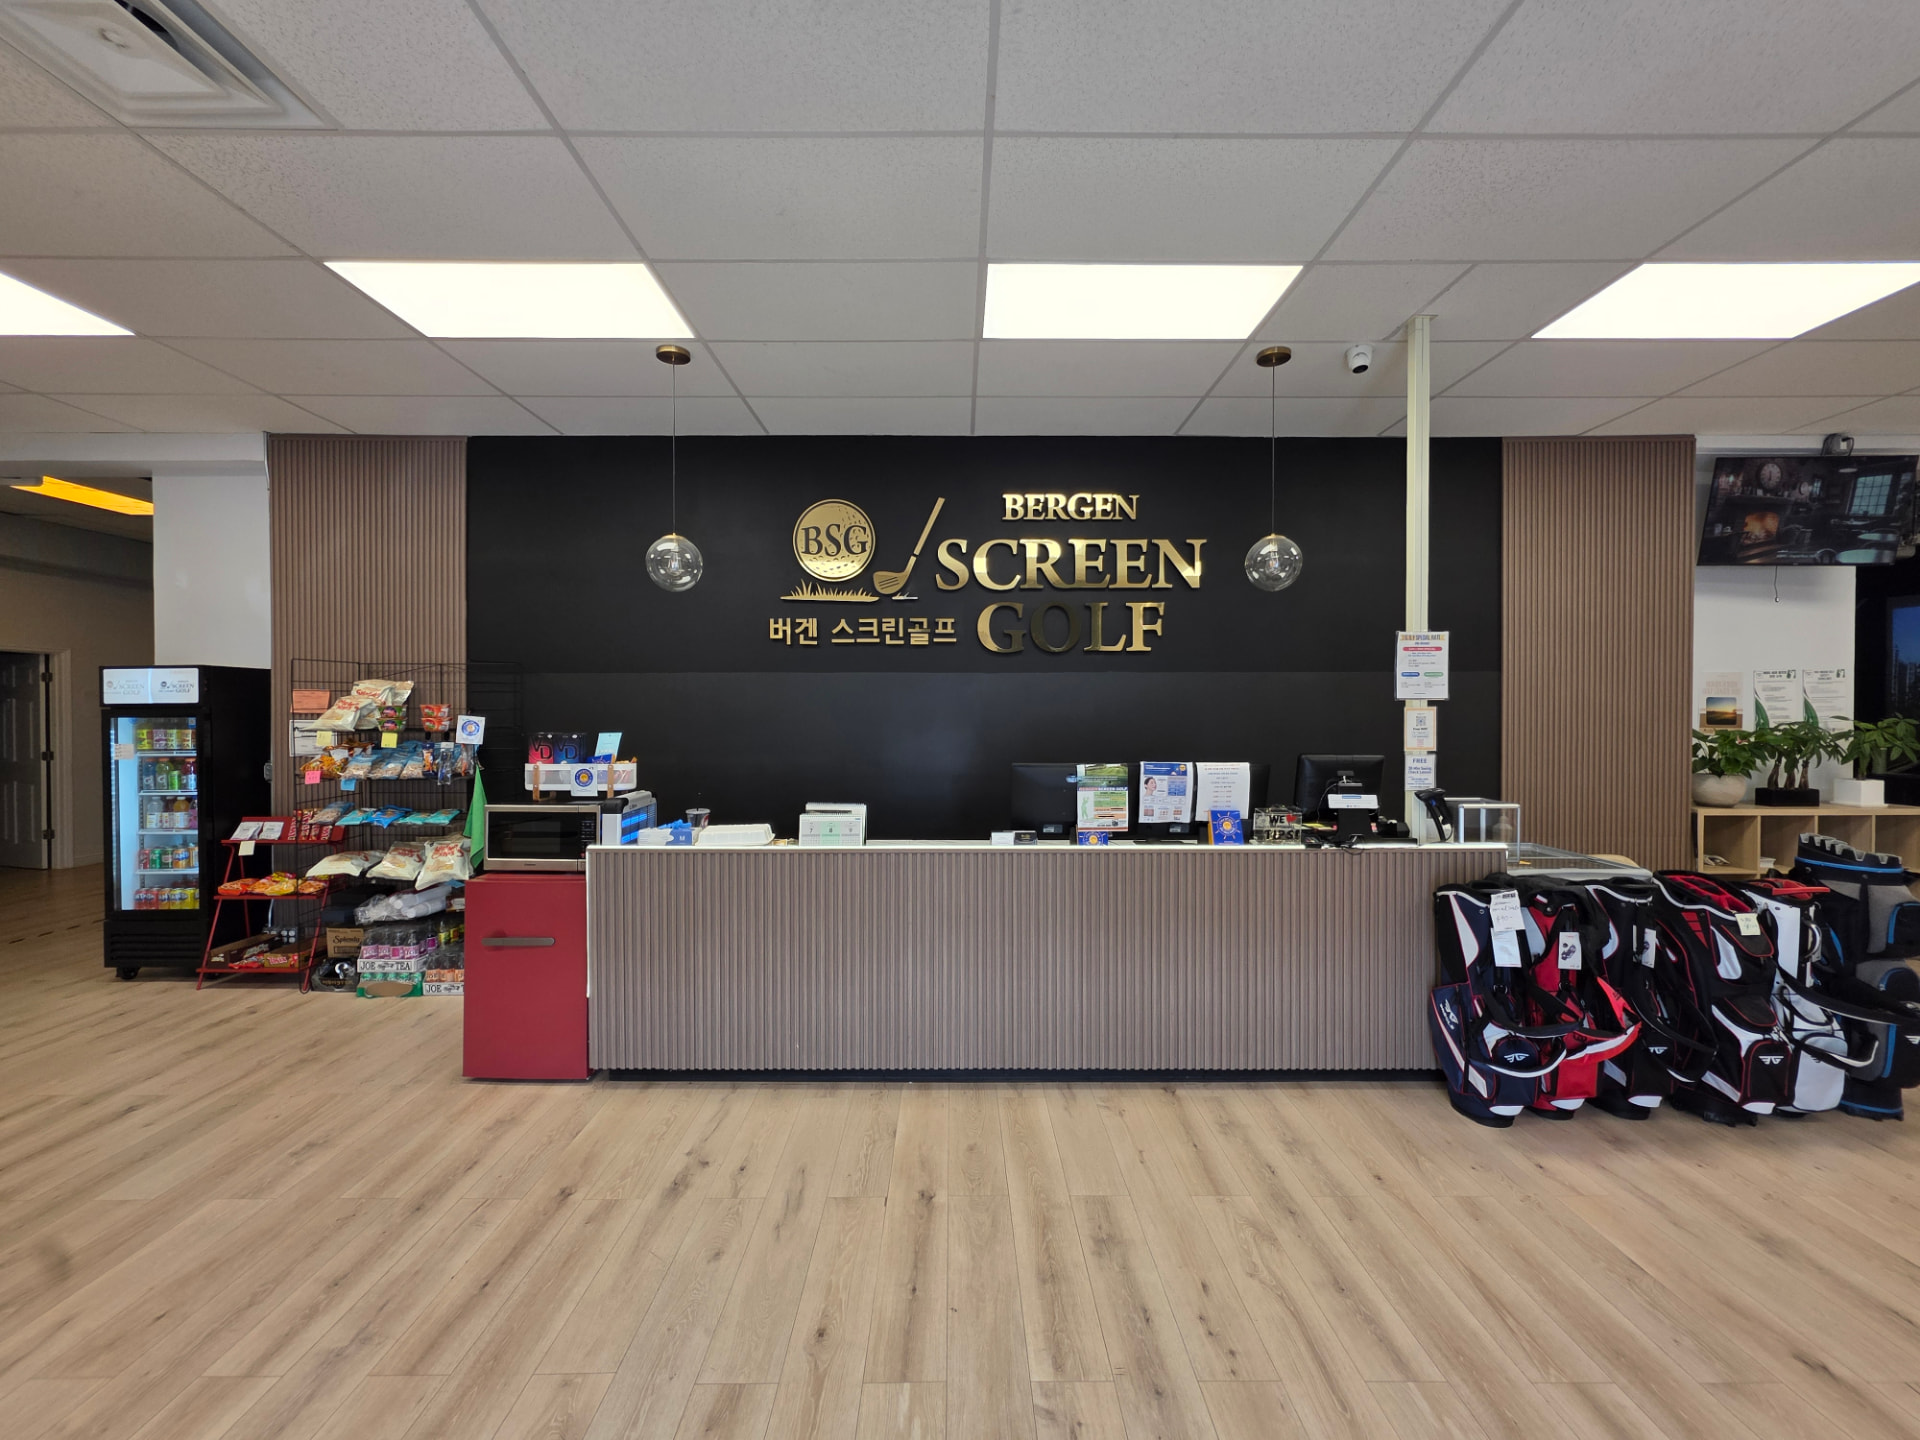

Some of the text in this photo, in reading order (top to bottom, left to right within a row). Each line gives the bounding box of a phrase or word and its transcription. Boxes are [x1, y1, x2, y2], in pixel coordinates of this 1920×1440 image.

[1002, 492, 1140, 521] BERGEN
[801, 524, 869, 557] BSG
[935, 538, 1208, 590] SCREEN
[769, 617, 958, 646] 버겐 스크린골프
[976, 601, 1166, 654] GOLF
[1268, 814, 1286, 824] WE
[360, 961, 377, 971] JOE
[395, 962, 411, 971] TEA
[426, 984, 442, 993] JOE
